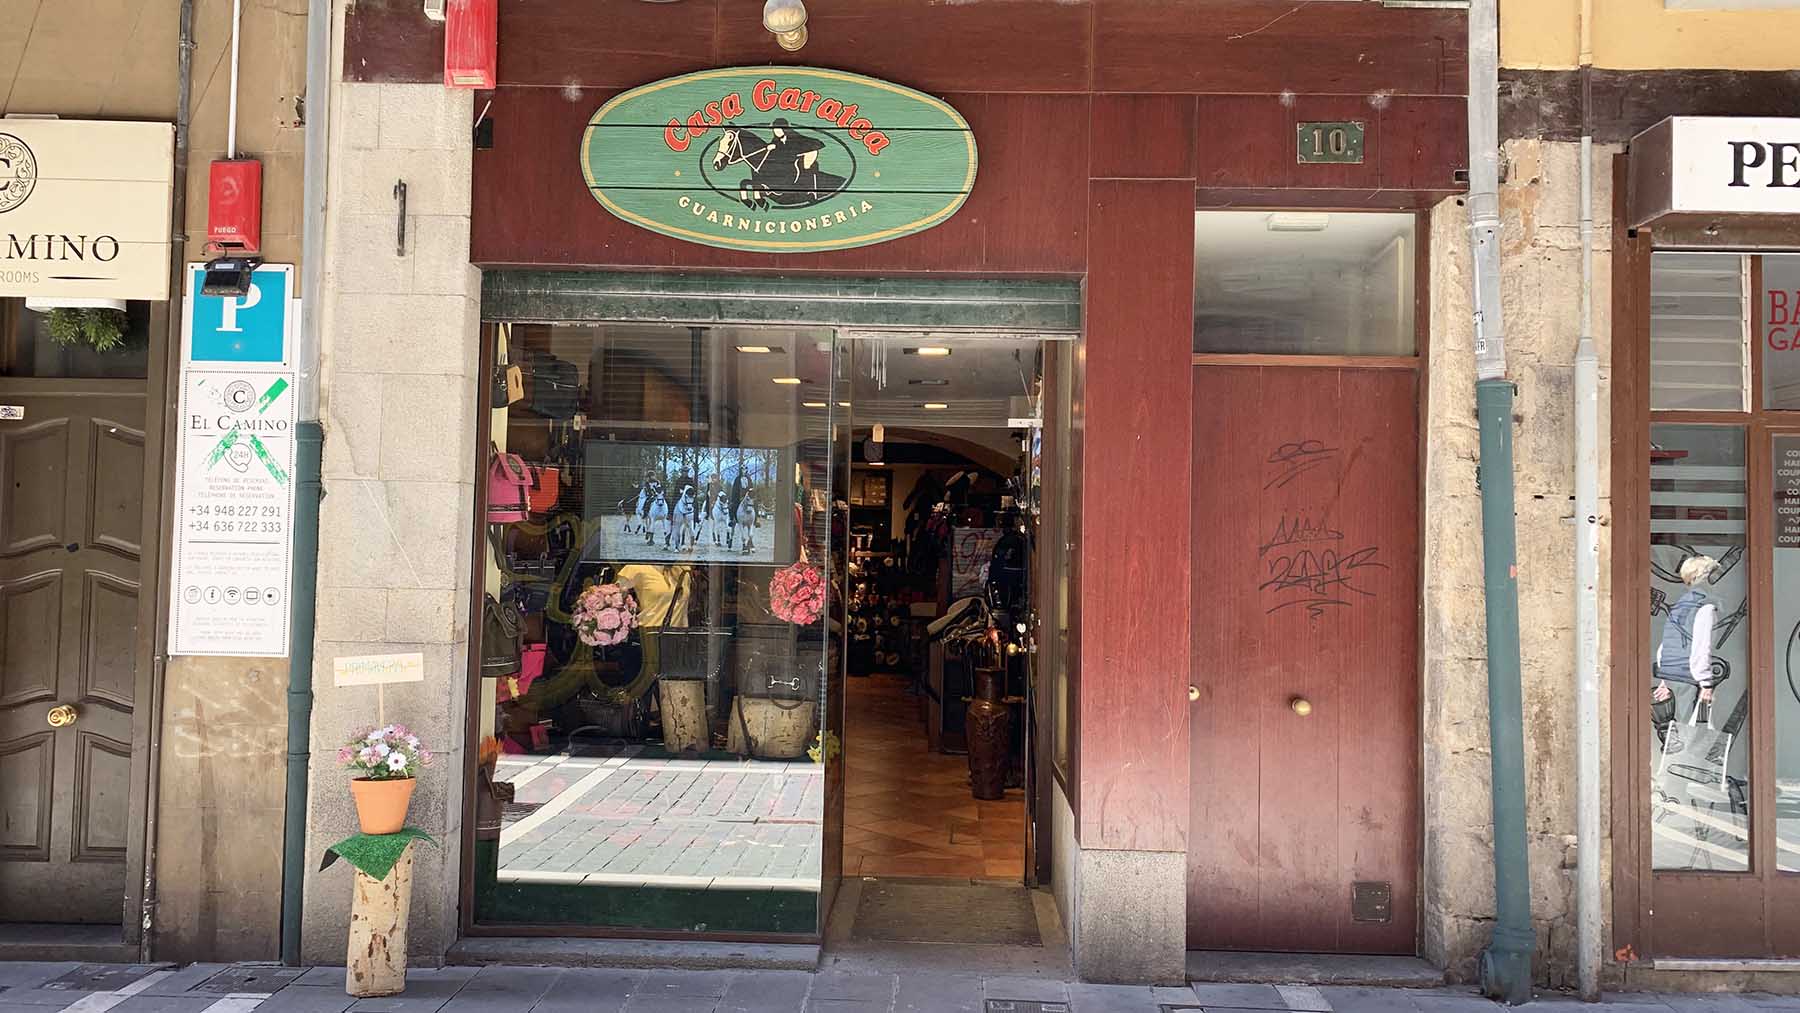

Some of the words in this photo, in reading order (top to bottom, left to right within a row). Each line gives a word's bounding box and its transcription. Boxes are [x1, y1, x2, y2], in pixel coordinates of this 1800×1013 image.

[663, 91, 744, 153] Casa
[752, 79, 891, 156] Garatea
[1312, 128, 1347, 156] 10
[1728, 141, 1800, 188] PE
[678, 196, 872, 234] GUARNICIONERIA
[0, 234, 120, 261] MINO
[233, 390, 246, 404] C
[188, 505, 210, 516] +34
[214, 505, 235, 516] 948
[238, 506, 258, 517] 227
[261, 506, 281, 517] 291
[188, 521, 210, 532] +34
[213, 521, 235, 532] 636
[238, 522, 258, 532] 722
[260, 522, 281, 533] 333
